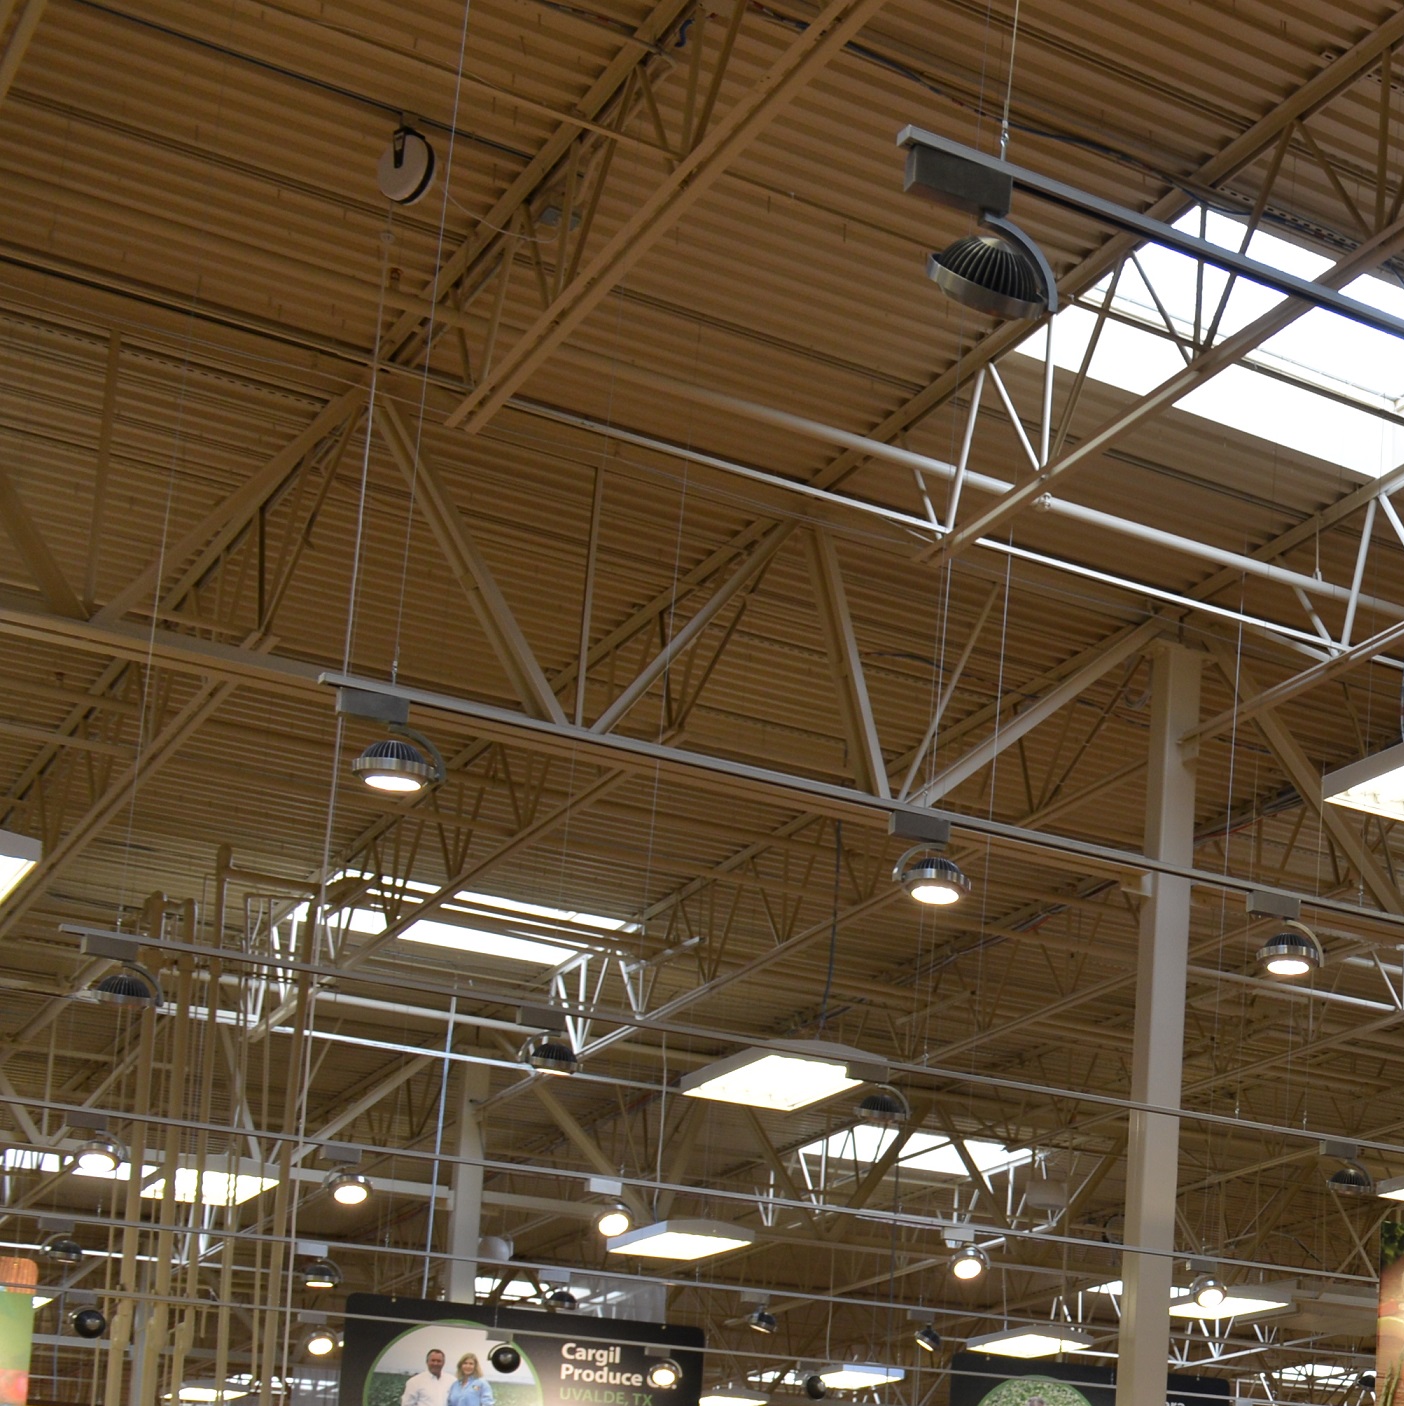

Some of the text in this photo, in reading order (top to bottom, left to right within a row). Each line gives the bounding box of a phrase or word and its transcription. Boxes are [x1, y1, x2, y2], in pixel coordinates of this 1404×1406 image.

[561, 1342, 621, 1366] Cargil
[560, 1363, 643, 1386] Produce
[560, 1387, 653, 1406] UVALDE, TX
